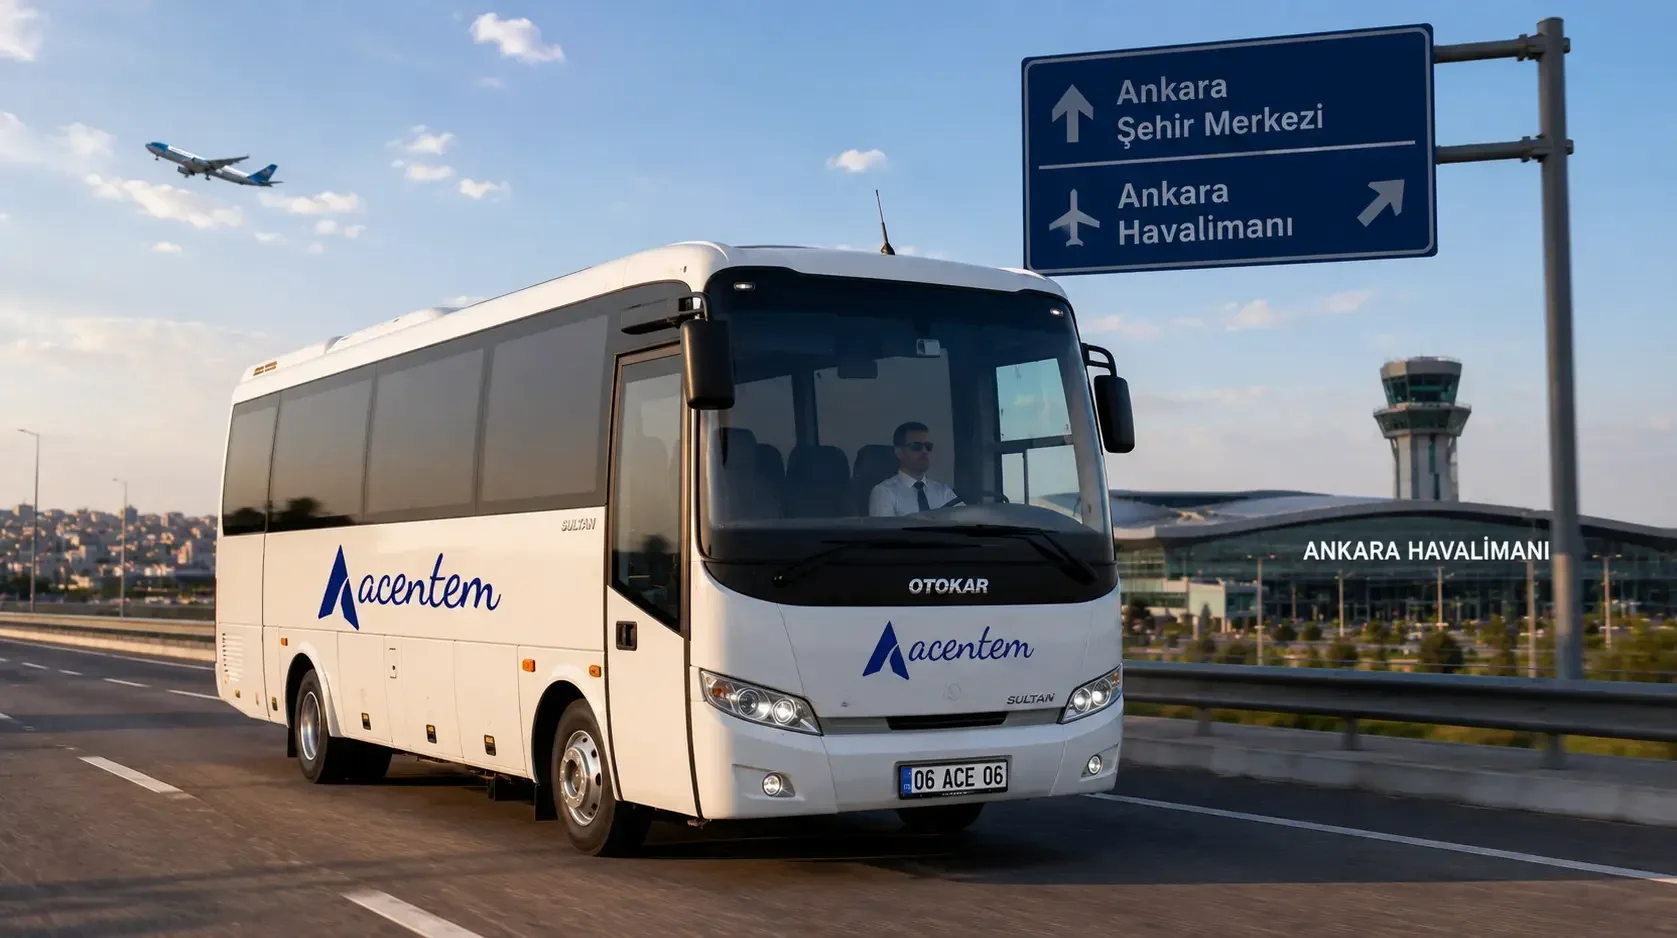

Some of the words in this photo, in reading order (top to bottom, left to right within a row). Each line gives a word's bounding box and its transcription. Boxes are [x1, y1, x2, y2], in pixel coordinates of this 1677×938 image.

[1117, 76, 1228, 105] Ankara
[1117, 112, 1195, 149] Şehir
[1204, 103, 1324, 137] Merkezi
[1117, 181, 1229, 209] Ankara
[1118, 215, 1293, 246] Havalimanı
[561, 517, 596, 531] SULTAN
[1303, 540, 1401, 561] ANKARA
[1408, 536, 1550, 560] HAVALİMANI
[908, 578, 989, 594] OTOKAR
[1007, 692, 1056, 705] SULTAN
[914, 769, 935, 790] 06
[942, 767, 975, 789] ACE
[983, 765, 1003, 786] 06
